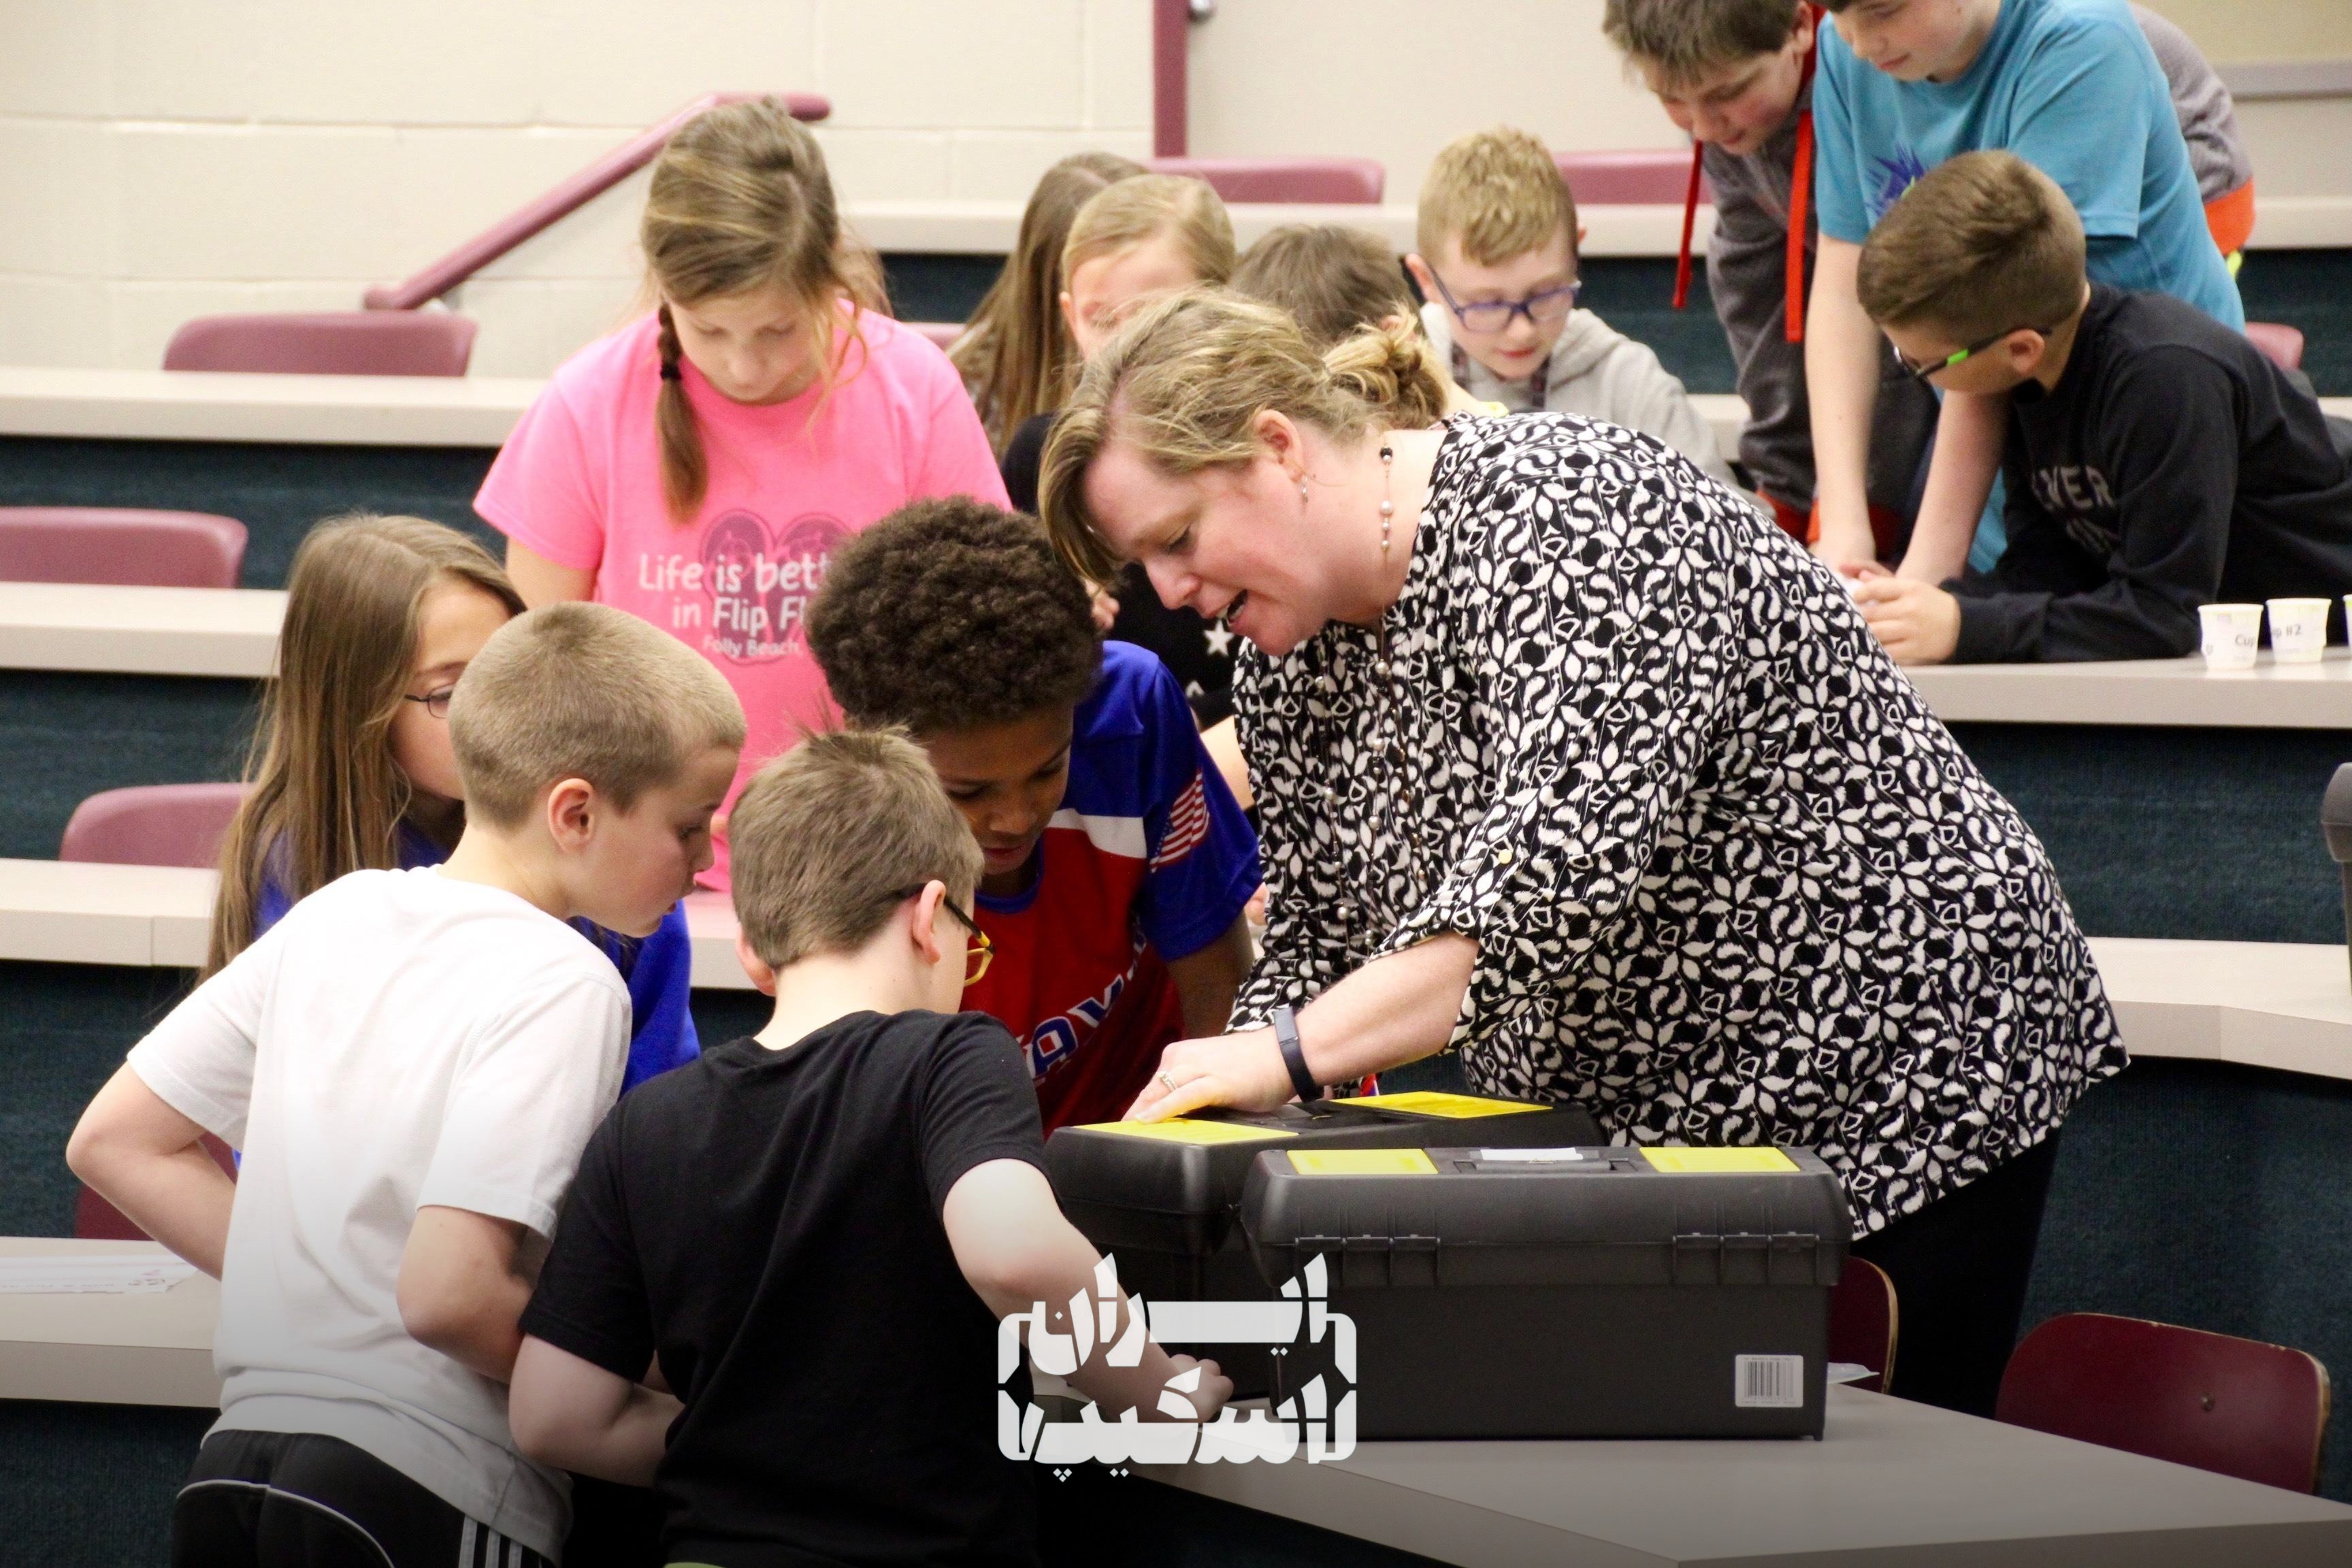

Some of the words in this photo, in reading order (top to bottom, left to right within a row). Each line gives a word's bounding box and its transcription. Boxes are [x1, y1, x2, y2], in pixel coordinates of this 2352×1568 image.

[639, 553, 704, 591] Life
[716, 555, 743, 593] is
[755, 552, 834, 593] bett
[672, 597, 702, 629] in
[713, 596, 768, 637] Flip
[779, 595, 807, 630] Fl
[702, 634, 743, 658] Folly
